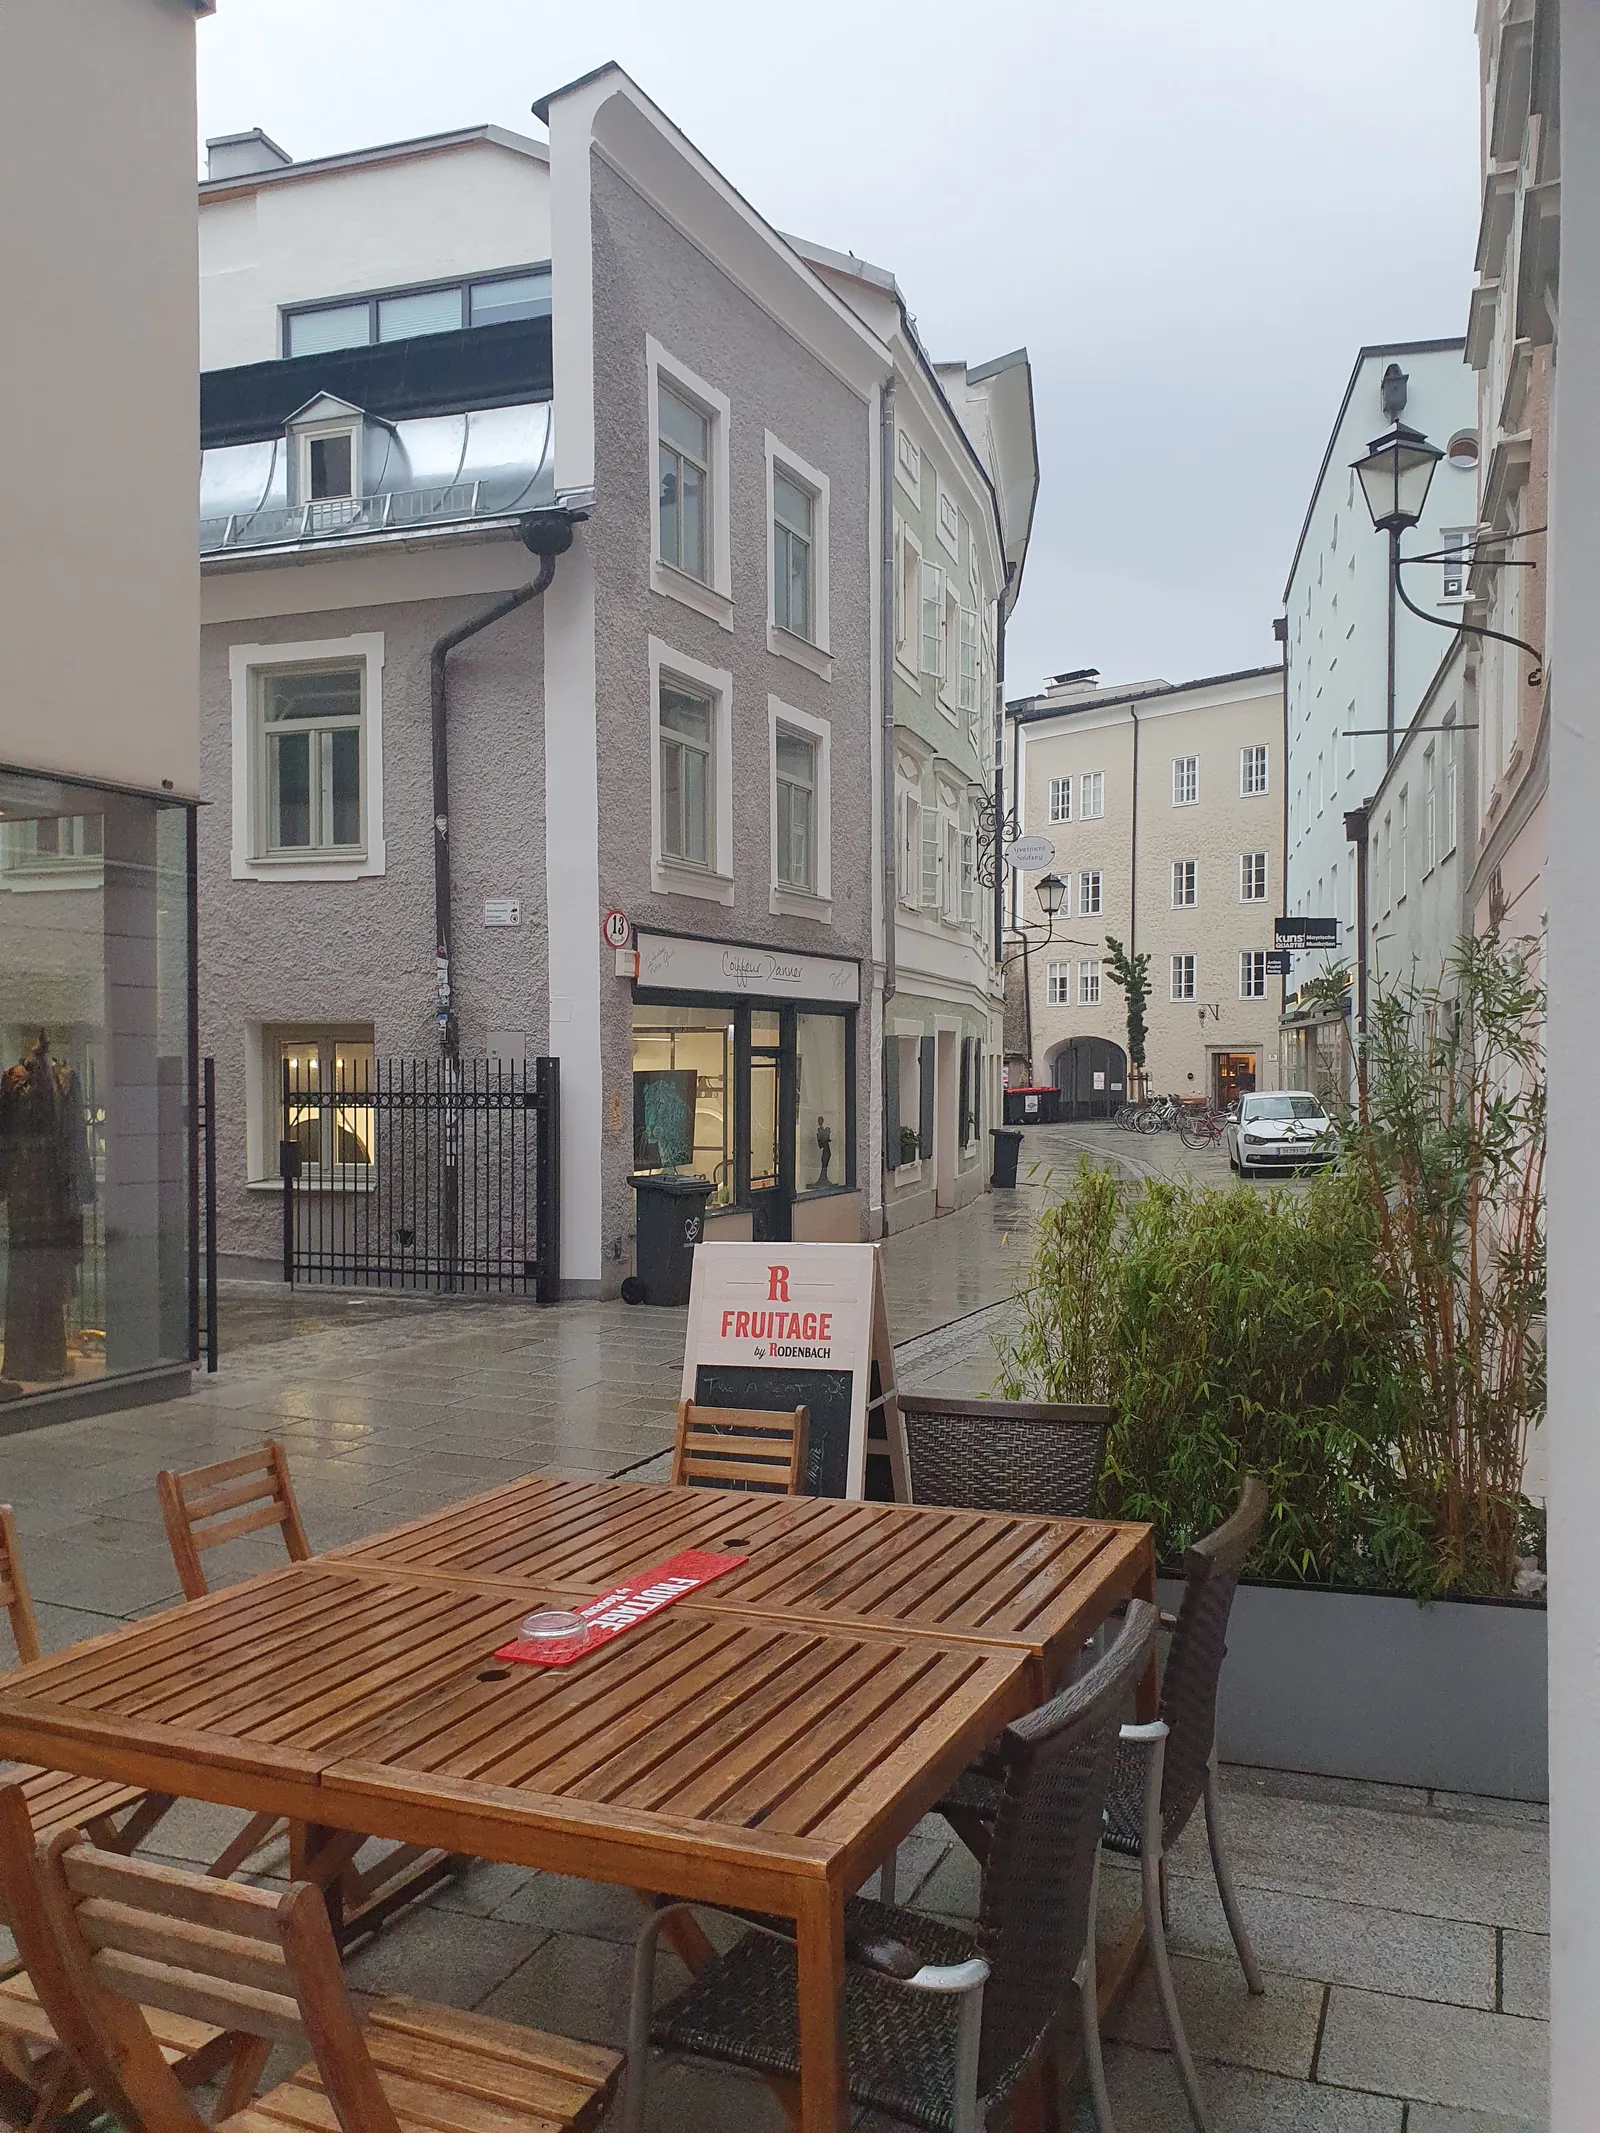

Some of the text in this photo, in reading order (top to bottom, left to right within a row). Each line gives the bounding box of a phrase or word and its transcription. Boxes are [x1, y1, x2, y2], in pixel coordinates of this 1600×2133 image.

[612, 914, 625, 936] 13
[721, 950, 762, 988] Coiffeur
[766, 1265, 791, 1303] R
[721, 1310, 833, 1341] FRUITAGE
[753, 1342, 831, 1361] by RODENBACH
[586, 1576, 702, 1633] FRUITAGE
